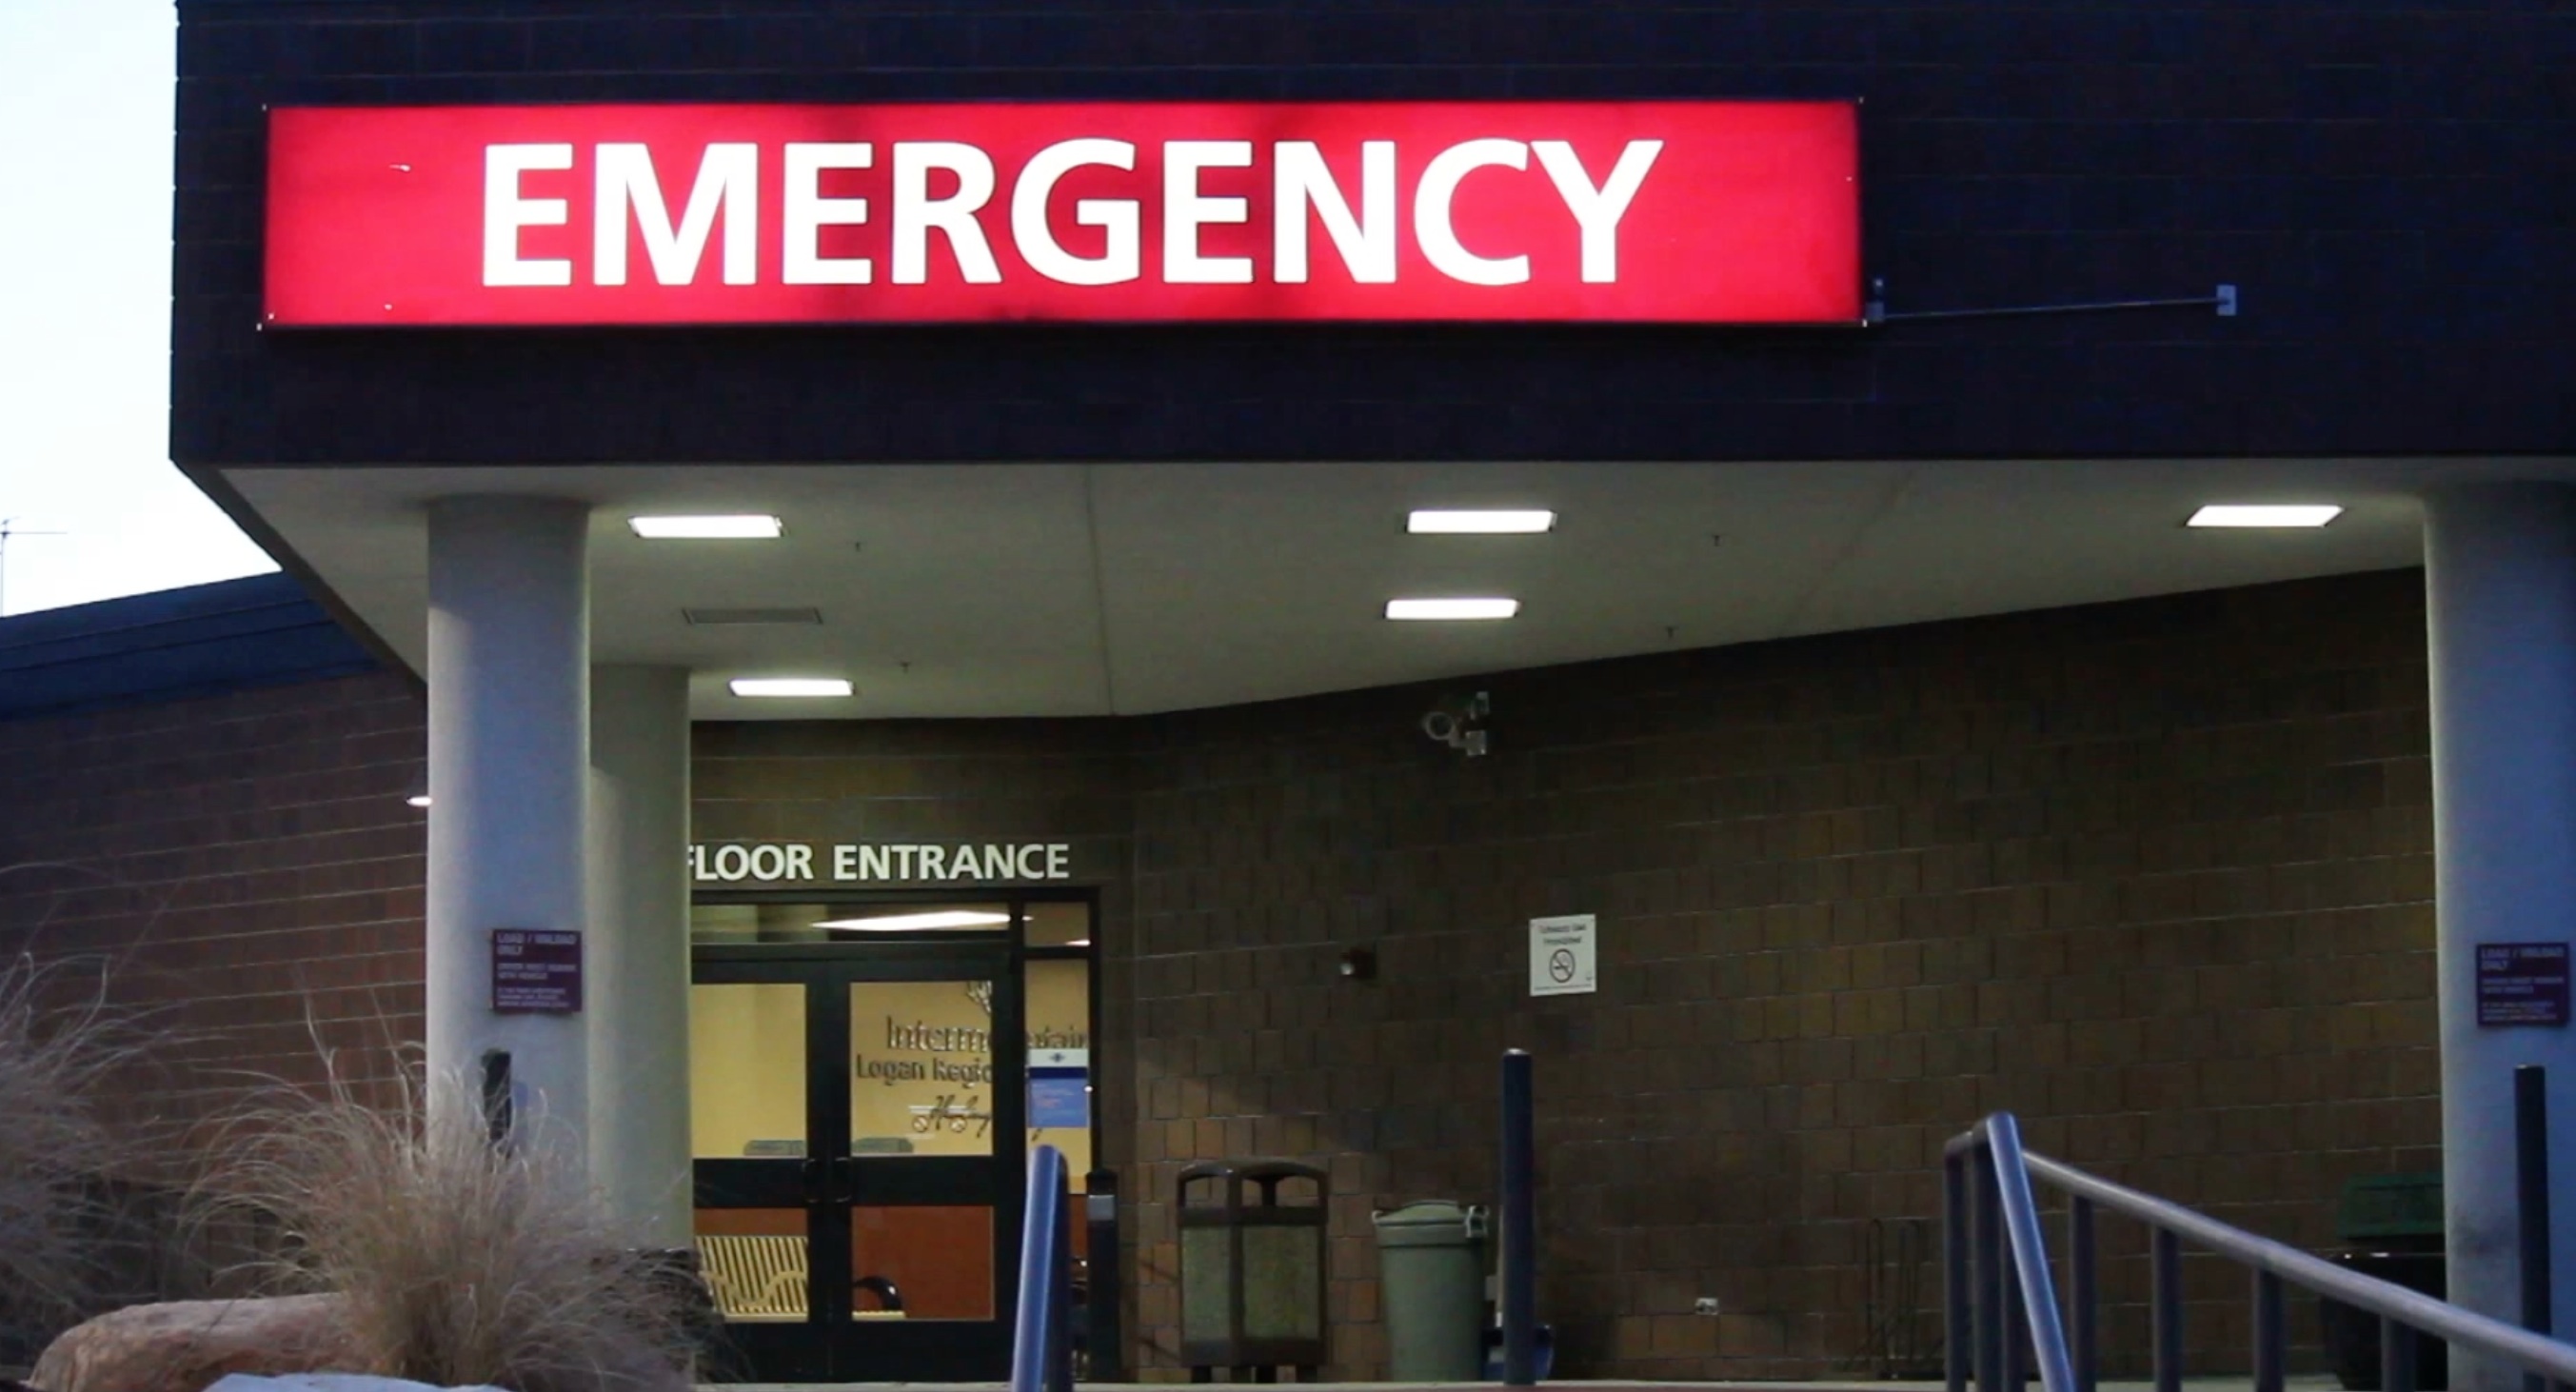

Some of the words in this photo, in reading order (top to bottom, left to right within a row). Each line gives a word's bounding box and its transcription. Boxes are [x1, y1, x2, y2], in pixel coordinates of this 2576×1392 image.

[483, 138, 1663, 287] EMERGENCY
[833, 844, 1070, 881] ENTRANCE
[857, 1054, 924, 1086] Logan
